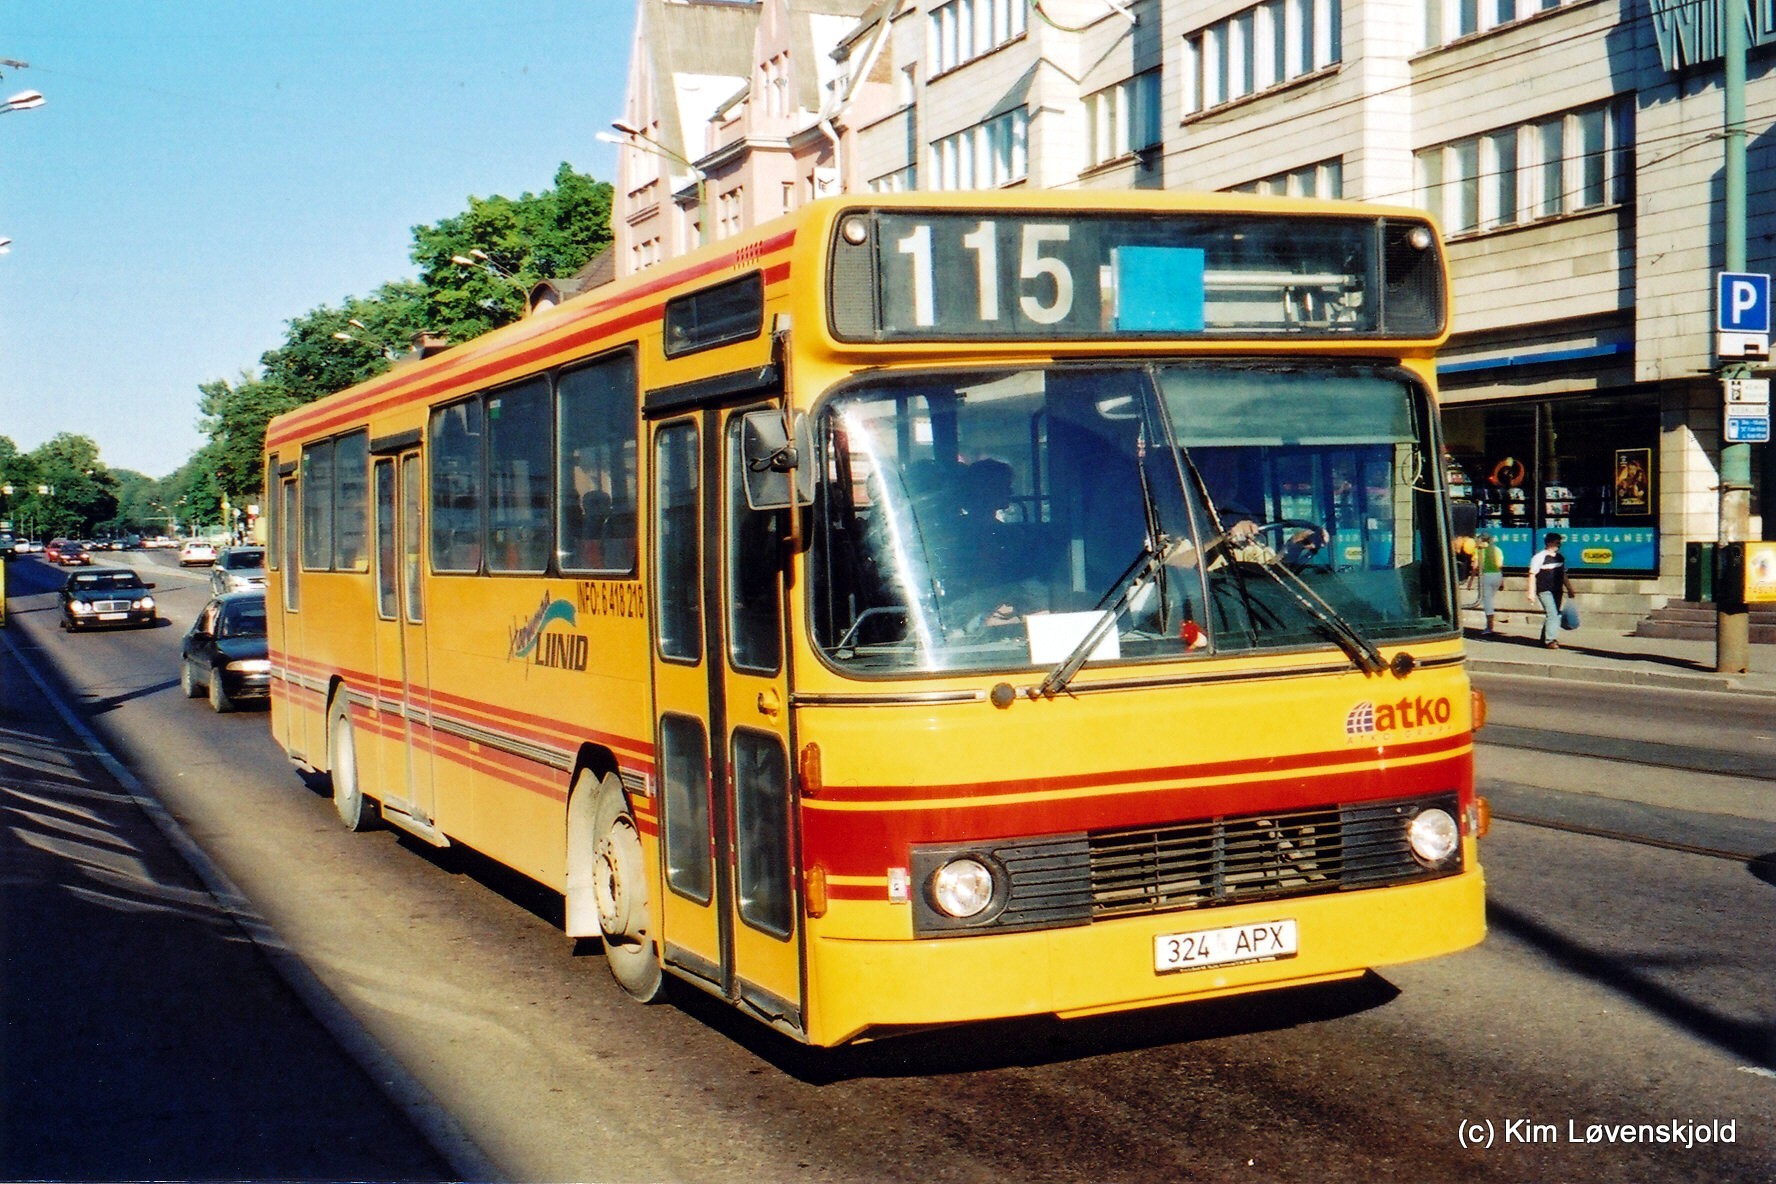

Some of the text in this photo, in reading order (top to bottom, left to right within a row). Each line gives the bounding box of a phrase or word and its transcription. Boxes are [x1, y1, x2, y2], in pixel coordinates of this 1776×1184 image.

[899, 221, 1073, 326] 115
[1732, 280, 1758, 324] P
[1543, 533, 1653, 543] DEOPLANET
[577, 581, 600, 615] INFO:
[535, 632, 589, 672] LIINID
[1375, 697, 1451, 732] atko
[1168, 925, 1283, 963] 324 APX
